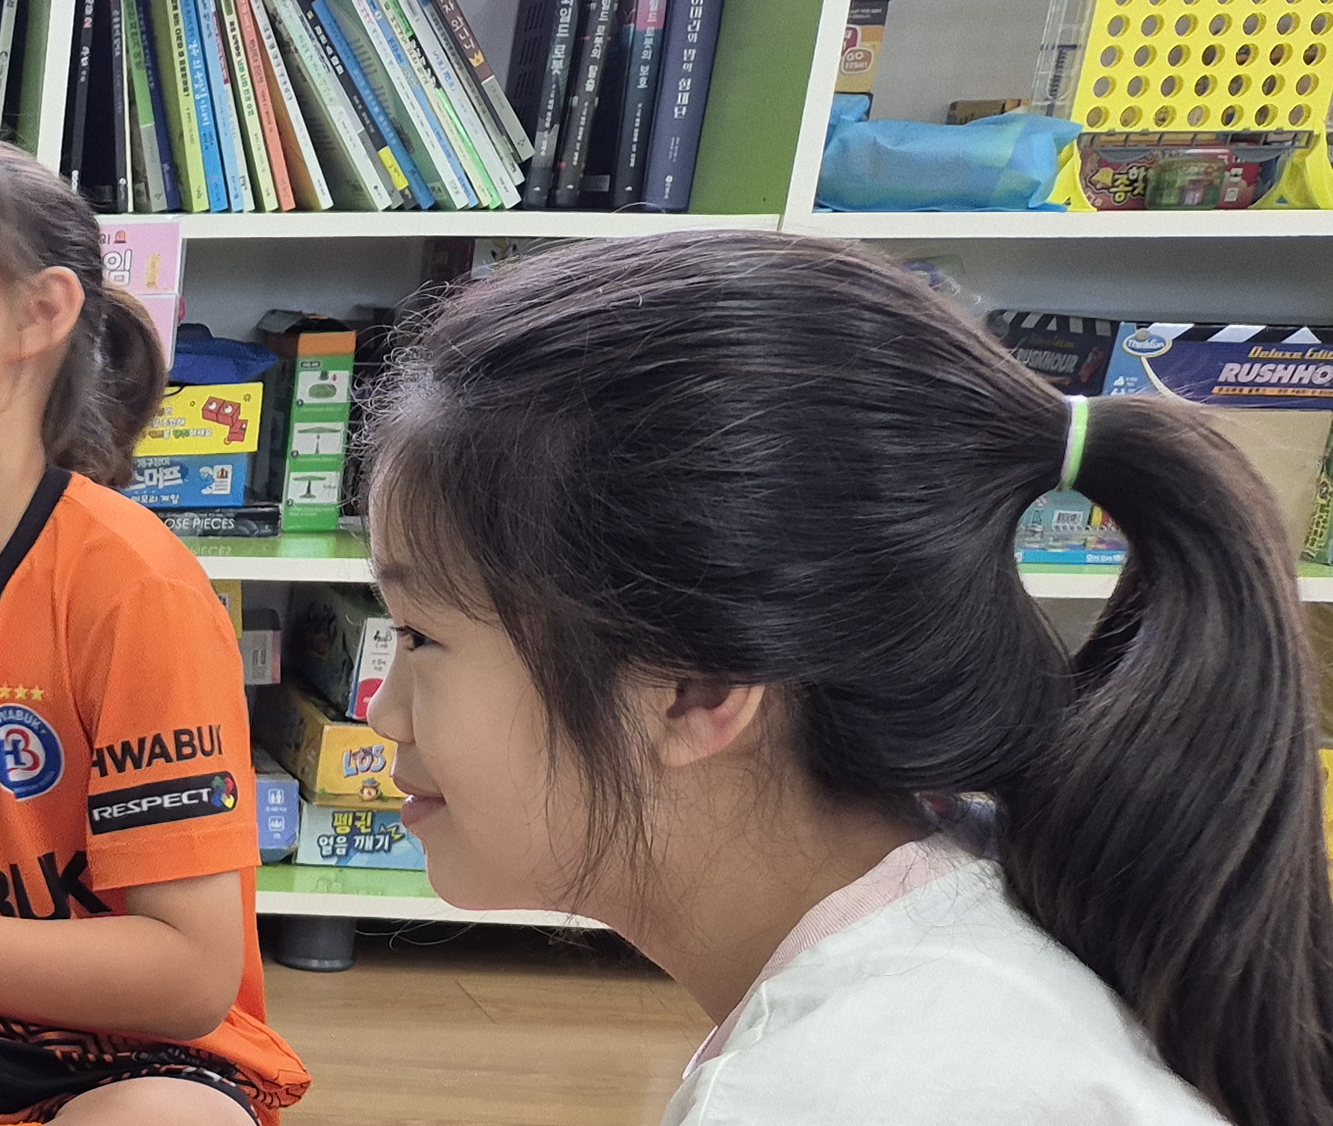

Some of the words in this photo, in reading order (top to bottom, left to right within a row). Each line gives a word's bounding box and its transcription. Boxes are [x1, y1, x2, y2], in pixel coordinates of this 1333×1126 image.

[193, 517, 236, 530] PIECES
[92, 787, 211, 822] RESPECT
[333, 812, 373, 834] 펭귄
[318, 835, 348, 859] 얼음
[354, 835, 390, 853] 깨기
